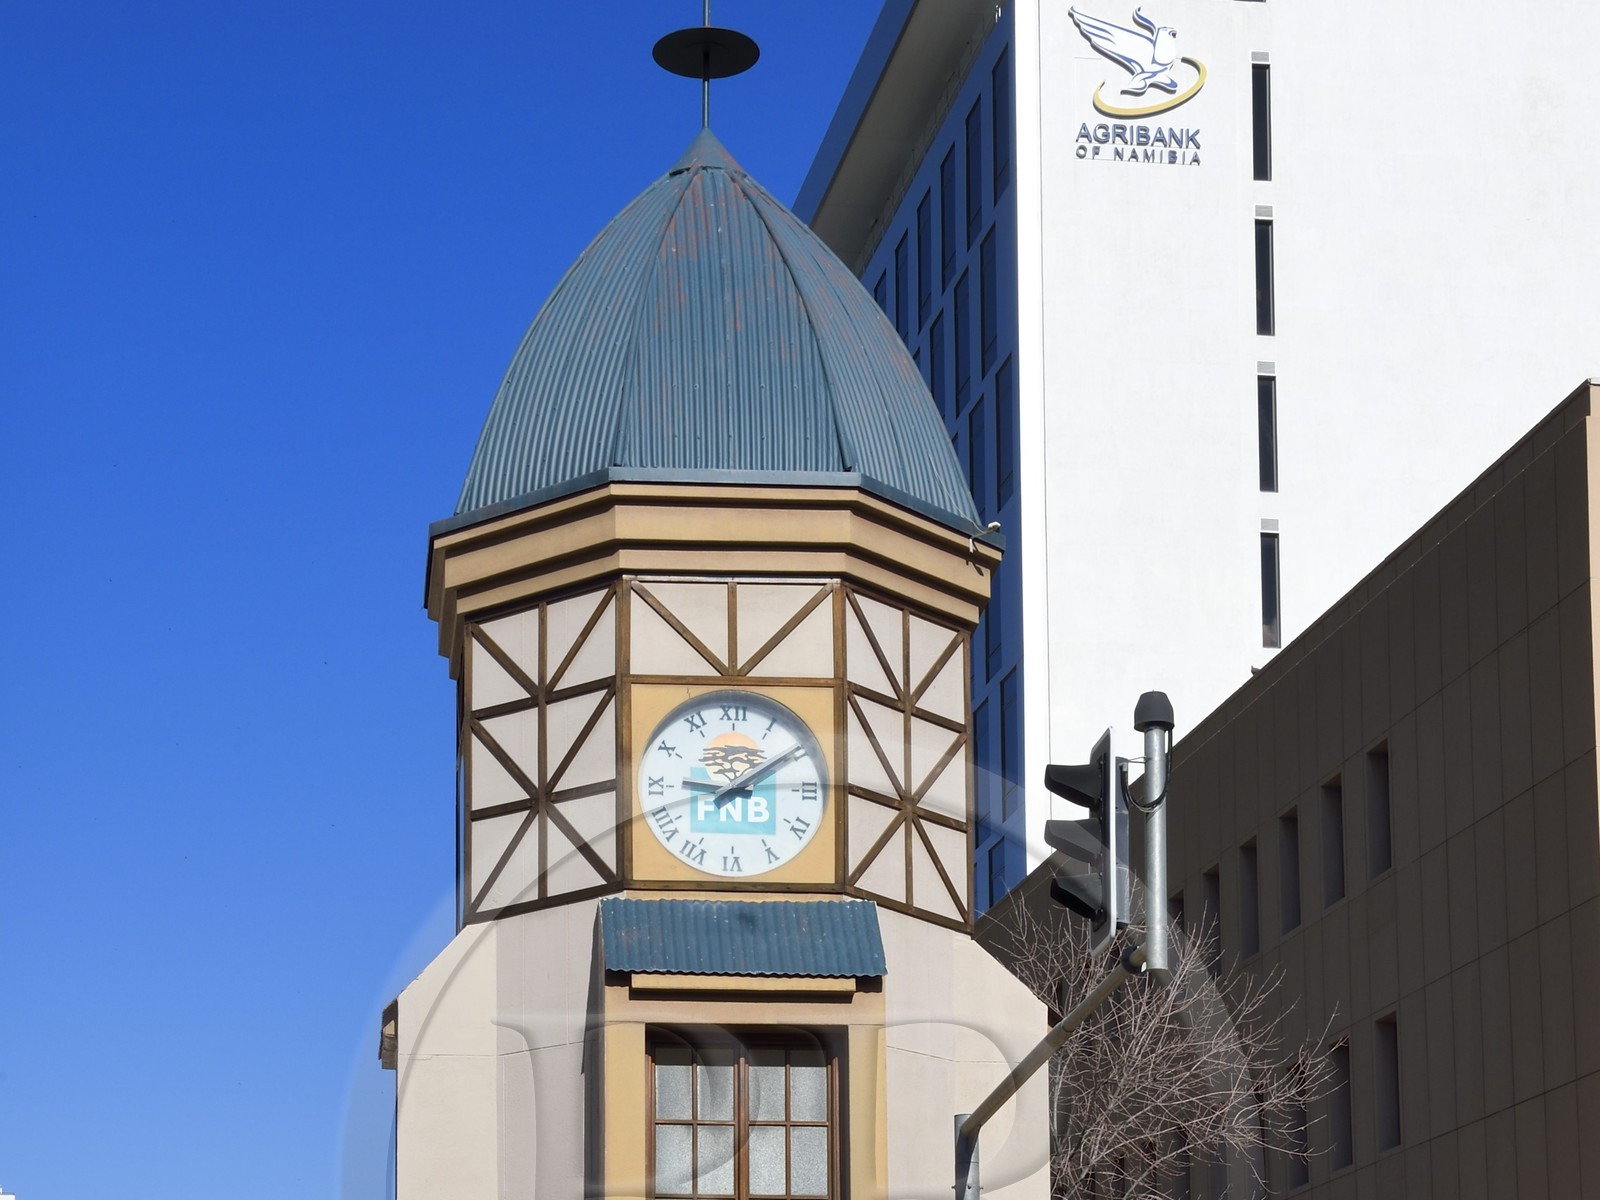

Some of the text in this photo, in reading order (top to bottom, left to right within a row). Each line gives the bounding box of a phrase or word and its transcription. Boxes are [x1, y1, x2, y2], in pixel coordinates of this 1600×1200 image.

[1075, 122, 1201, 149] AGRIBANK
[1075, 144, 1201, 166] OF NAMIBIA
[683, 711, 708, 733] XI
[719, 704, 748, 721] XII
[657, 740, 676, 758] X
[648, 776, 664, 796] IX
[802, 781, 817, 801] III
[697, 795, 770, 823] FNB
[651, 806, 680, 843] VIII
[789, 816, 811, 841] IV
[679, 839, 708, 866] VII
[764, 847, 781, 864] V
[722, 856, 743, 872] VI
